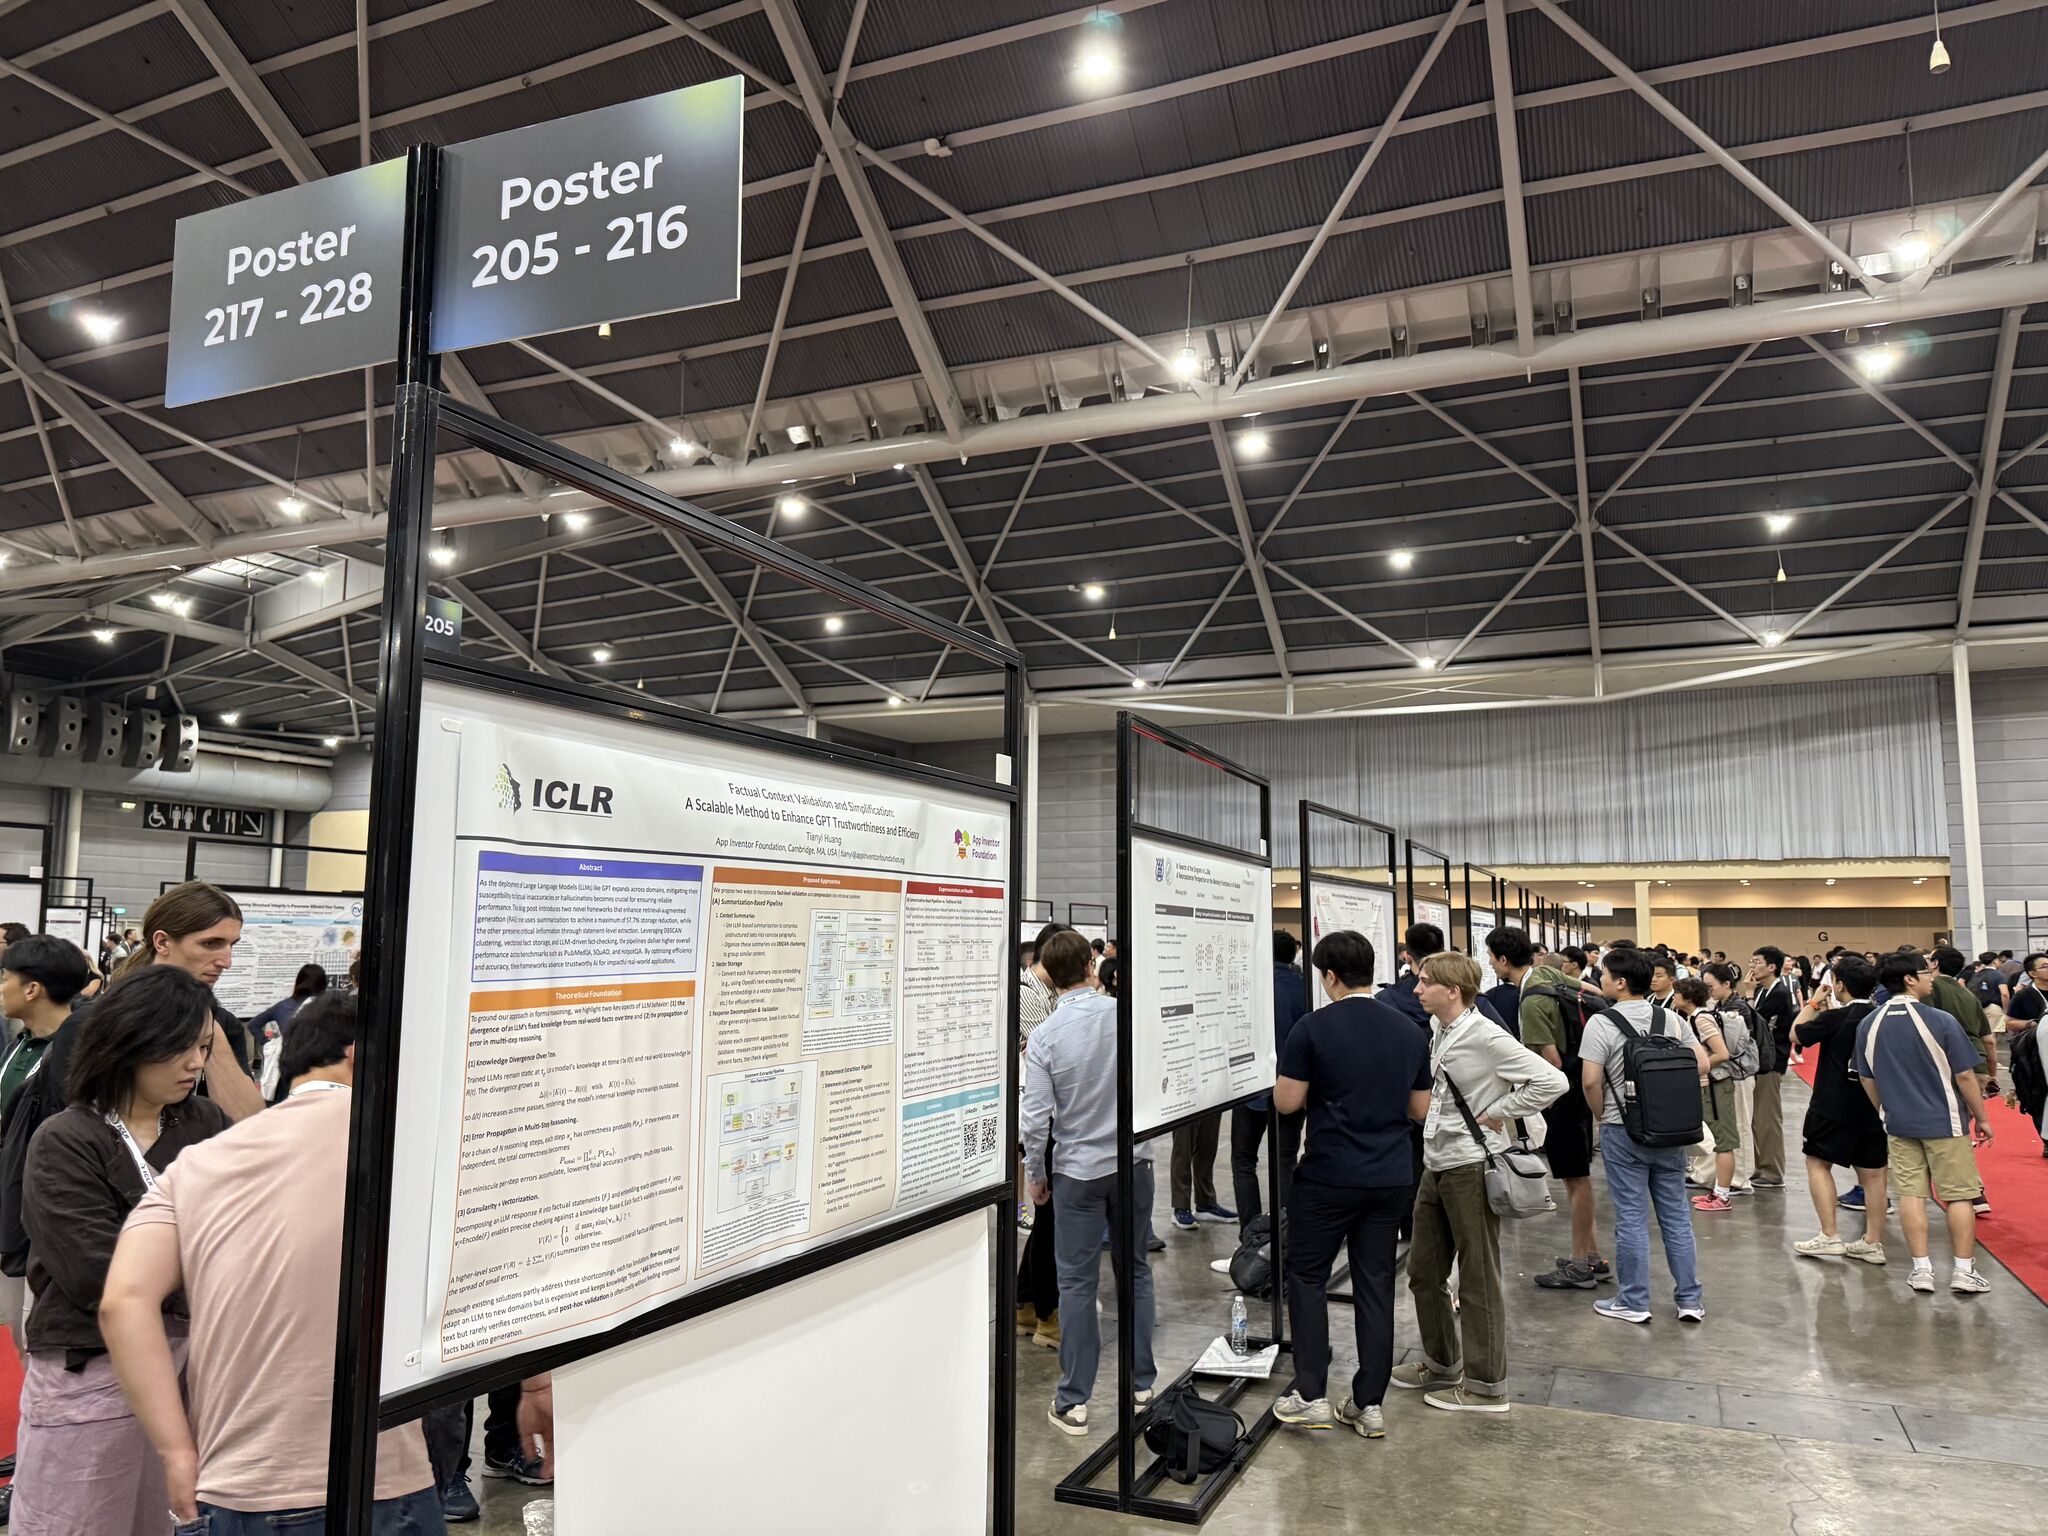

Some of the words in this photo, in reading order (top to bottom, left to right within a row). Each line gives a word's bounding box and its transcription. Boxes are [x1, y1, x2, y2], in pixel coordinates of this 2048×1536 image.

[501, 153, 663, 220] Poster
[227, 224, 356, 285] Poster
[471, 231, 559, 288] 205
[575, 244, 591, 255] -
[606, 204, 688, 261] 216
[203, 297, 264, 347] 217
[275, 309, 288, 320] -
[300, 271, 373, 325] 228
[425, 614, 454, 636] 205
[532, 778, 614, 815] ICLR
[684, 797, 693, 810] A
[695, 798, 733, 815] Scalable
[735, 803, 769, 819] Method
[770, 809, 780, 820] to
[781, 809, 814, 825] Enhance
[815, 814, 831, 827] GPT
[715, 836, 728, 847] App
[729, 838, 754, 848] Inventor
[578, 863, 603, 871] Abstract
[1818, 931, 1829, 941] G
[589, 989, 622, 997] Foundation
[460, 1340, 475, 1351] back
